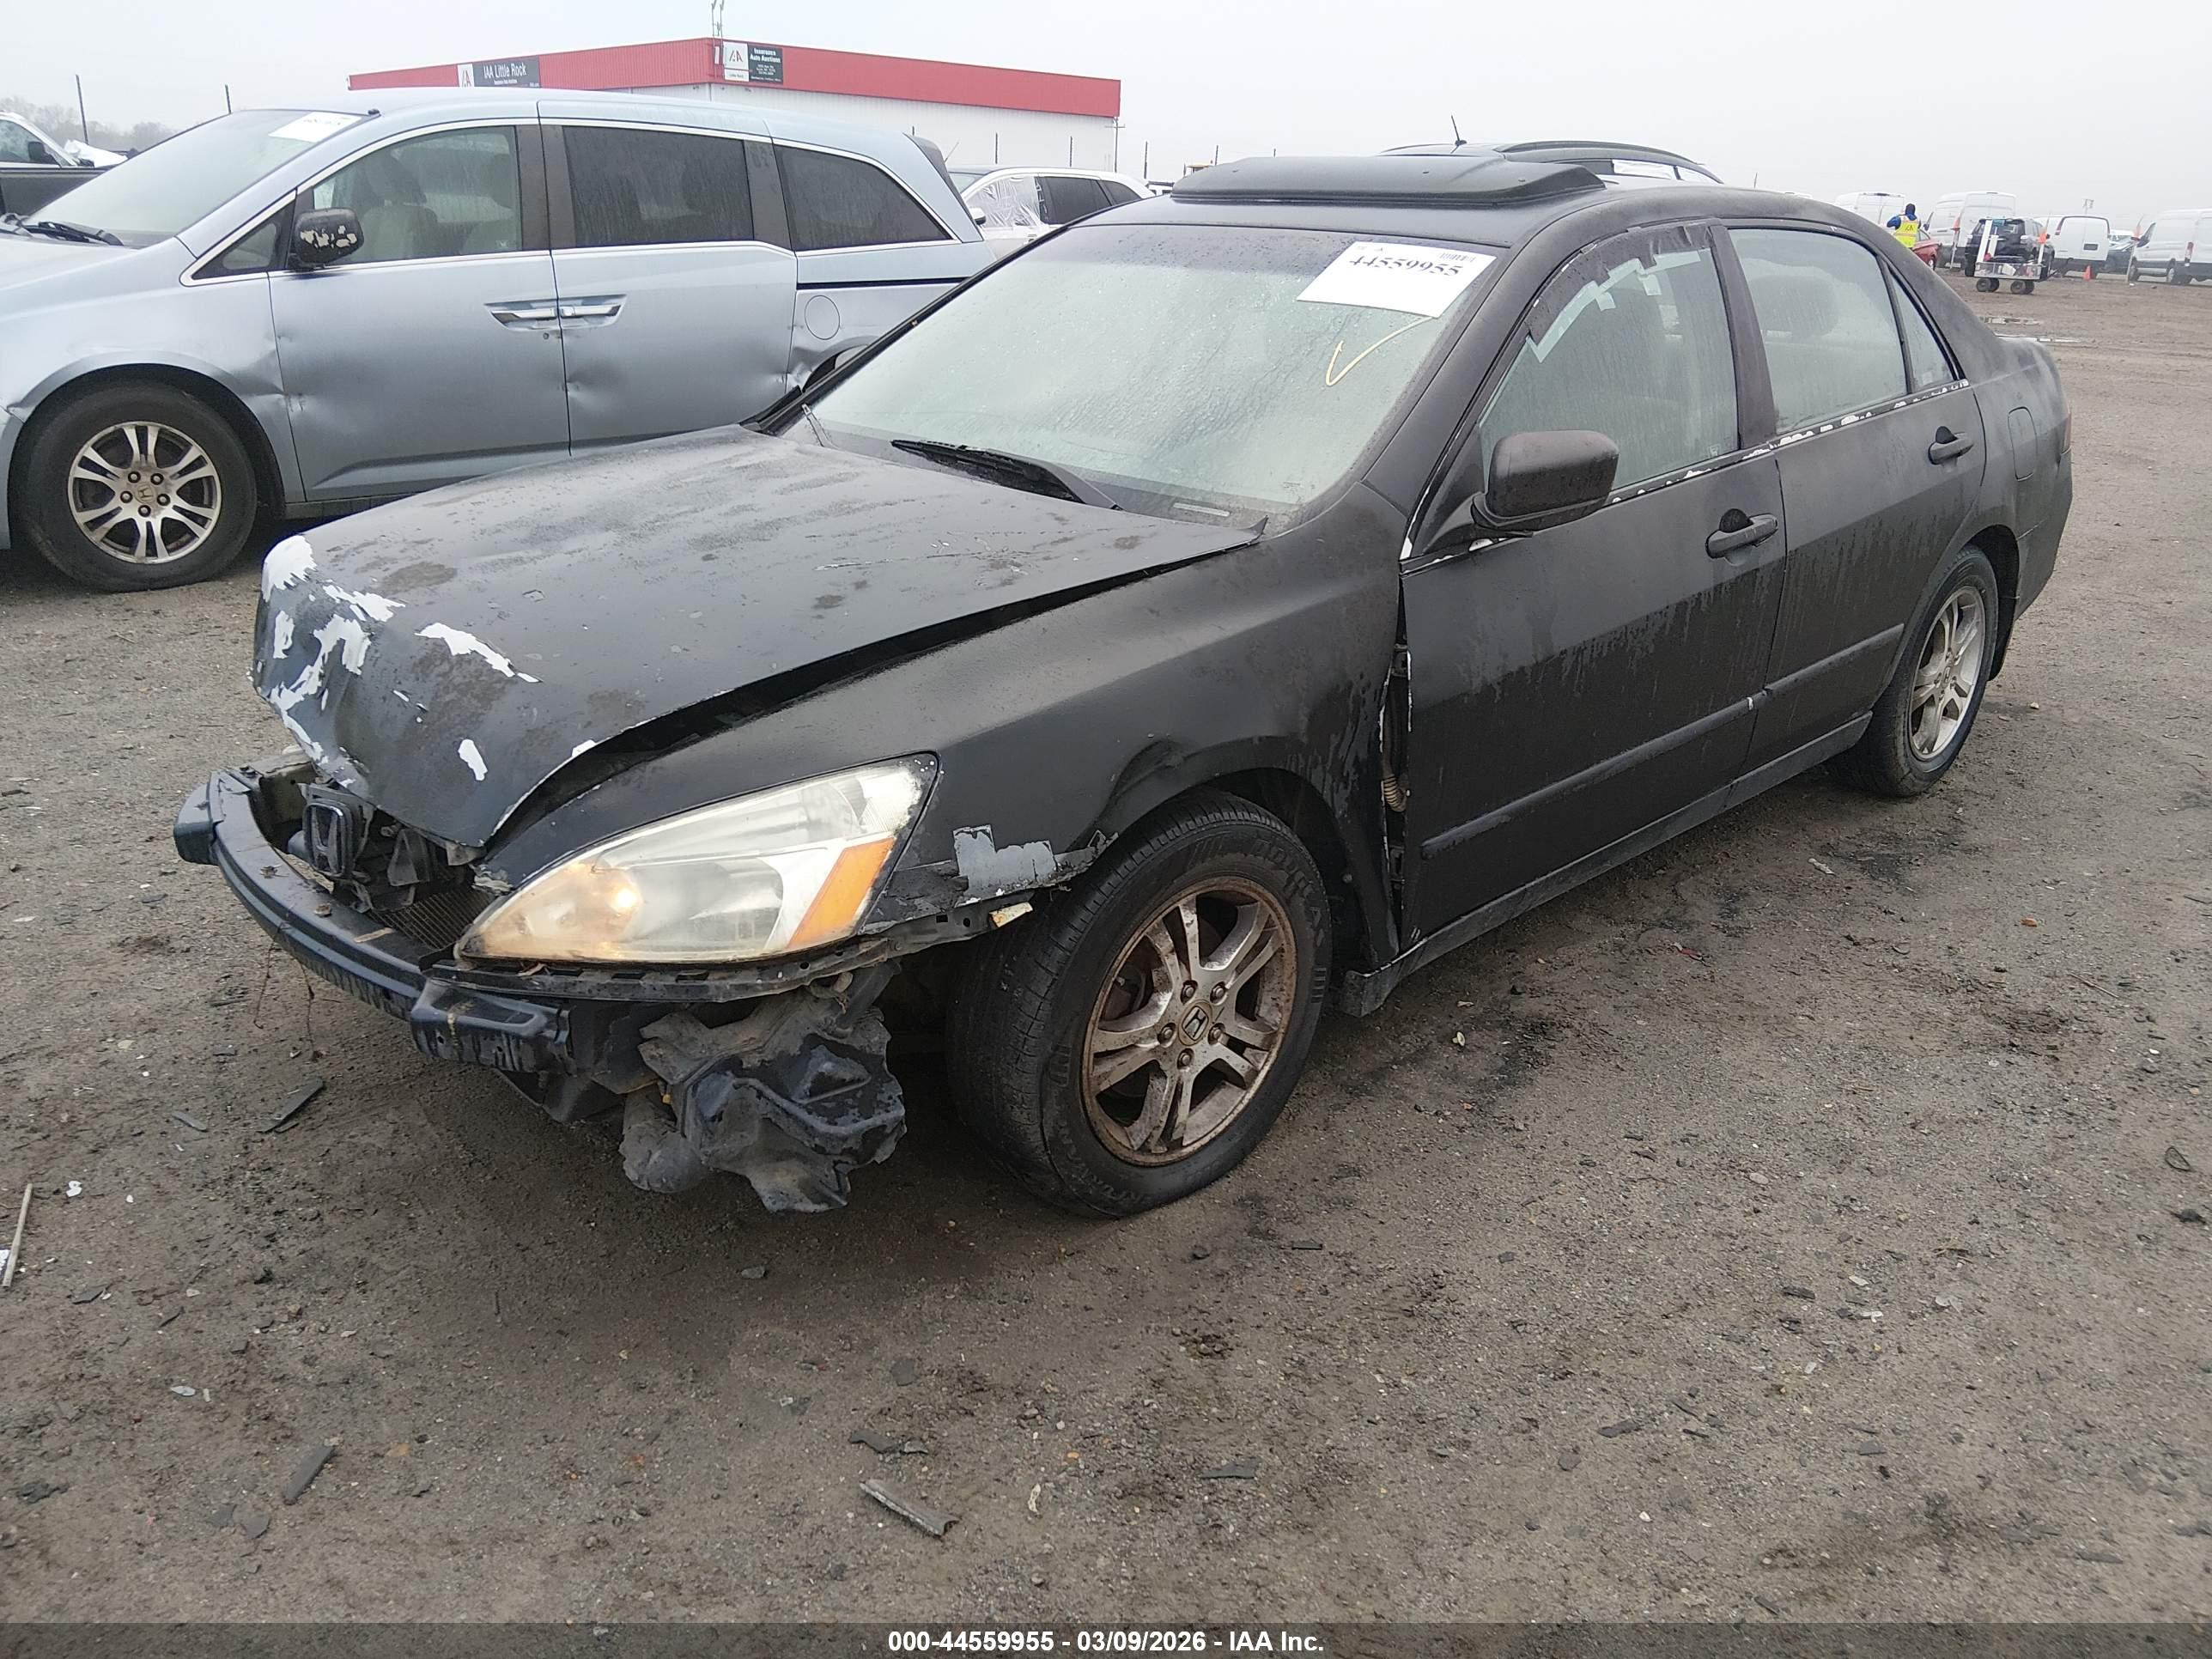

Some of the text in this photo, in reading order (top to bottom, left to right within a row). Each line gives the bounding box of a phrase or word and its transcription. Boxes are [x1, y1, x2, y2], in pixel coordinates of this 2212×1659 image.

[495, 64, 509, 77] Little
[511, 62, 526, 76] Rock
[1349, 256, 1463, 276] 44559955
